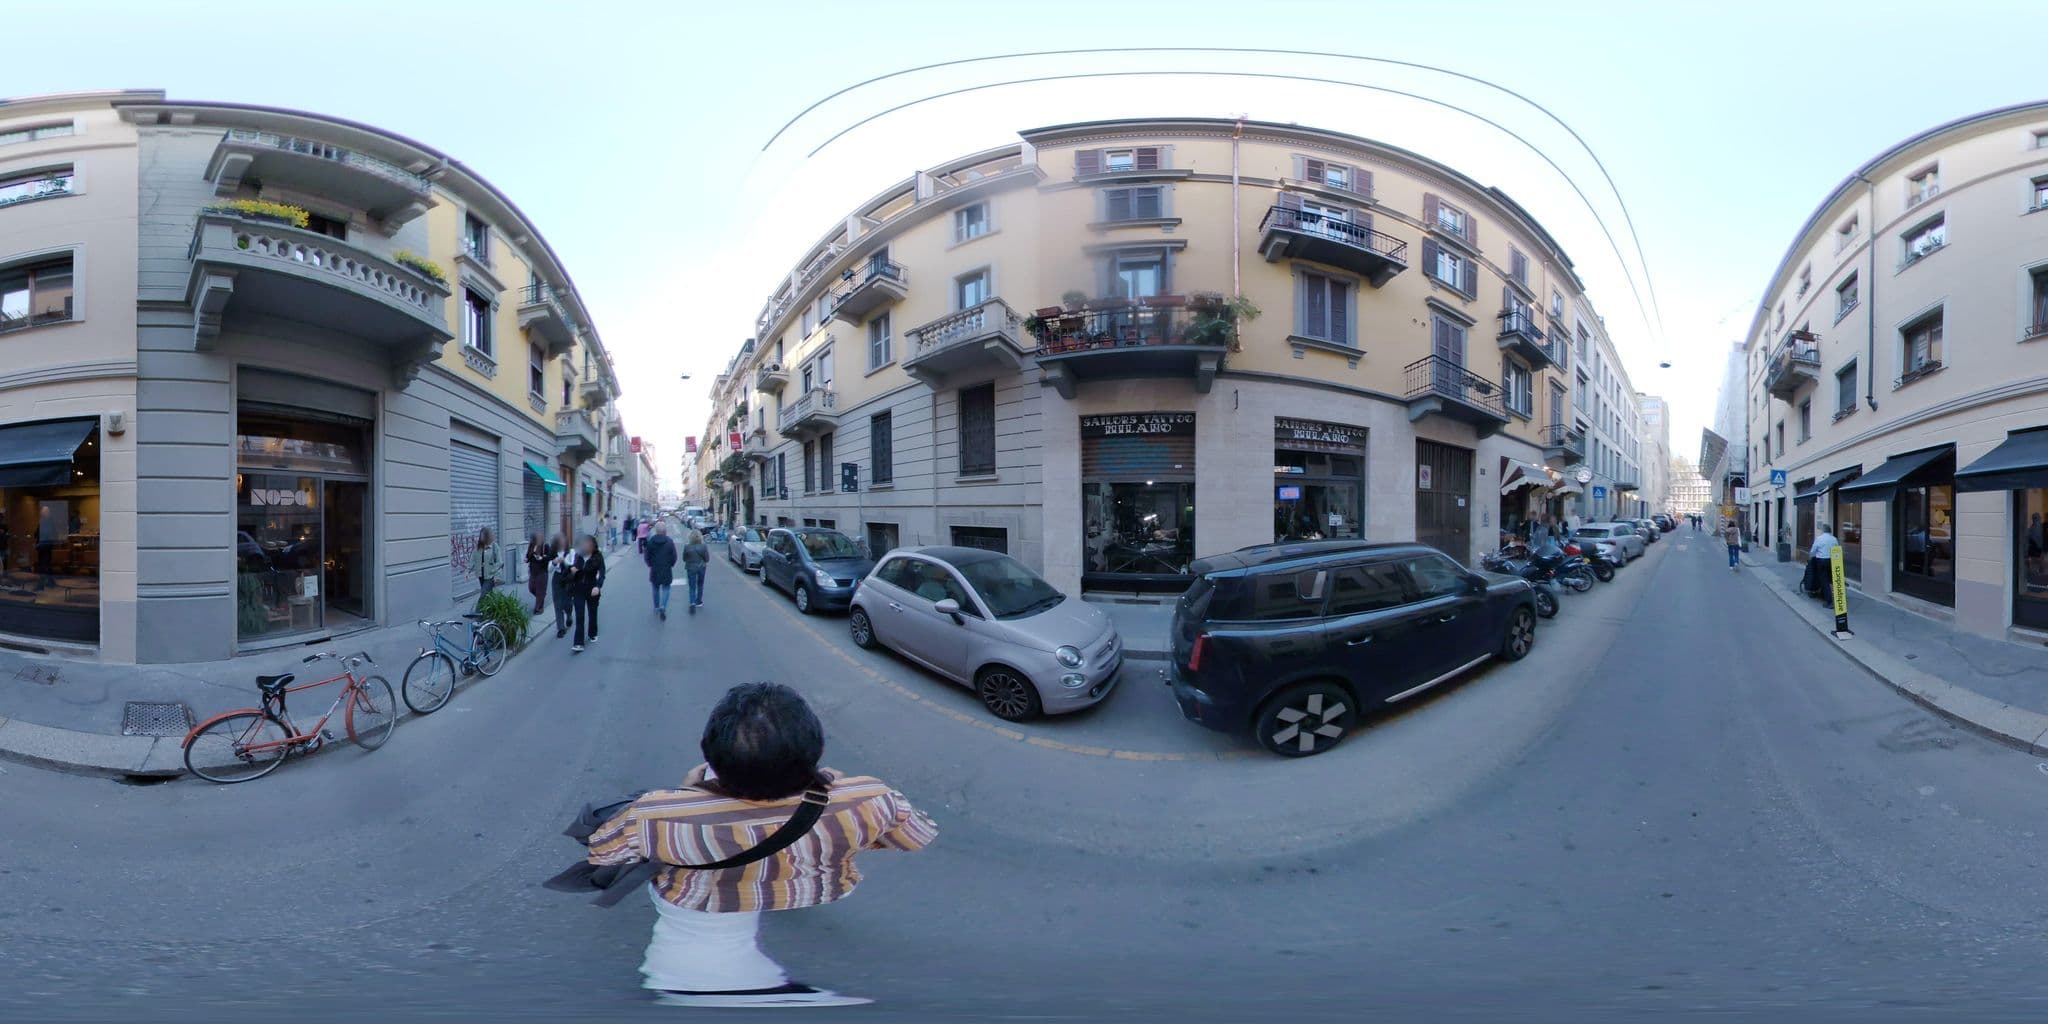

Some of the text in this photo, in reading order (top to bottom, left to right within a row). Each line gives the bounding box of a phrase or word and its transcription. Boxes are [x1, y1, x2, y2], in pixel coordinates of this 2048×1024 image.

[1083, 414, 1194, 427] SAILORS TATTOO
[1104, 423, 1172, 435] MILANO
[1327, 425, 1366, 437] TATTOO
[1293, 429, 1350, 444] MILANO
[1835, 566, 1844, 611] archiproducts
